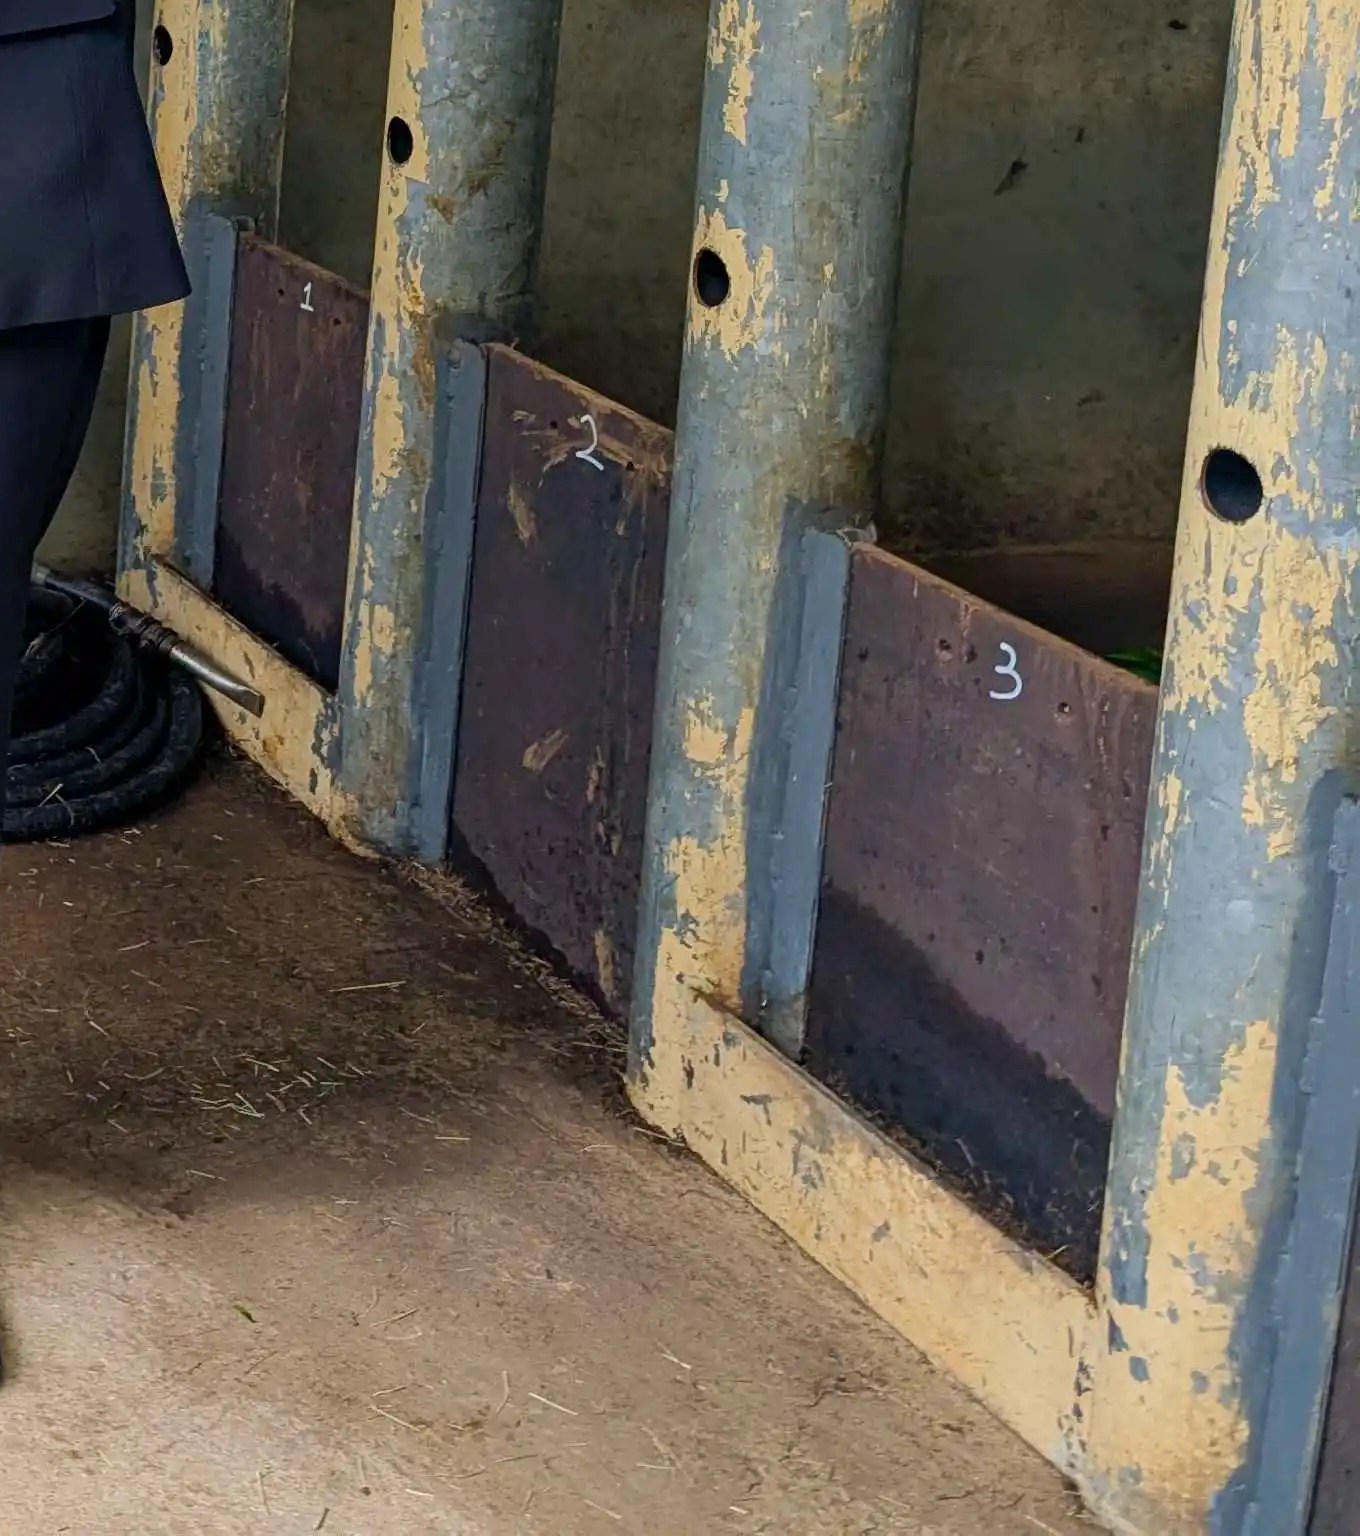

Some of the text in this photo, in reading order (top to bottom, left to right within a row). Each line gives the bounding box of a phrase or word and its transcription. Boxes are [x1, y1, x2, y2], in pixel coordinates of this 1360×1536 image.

[299, 281, 315, 313] 1
[575, 414, 605, 471] 2
[988, 641, 1023, 700] 3
